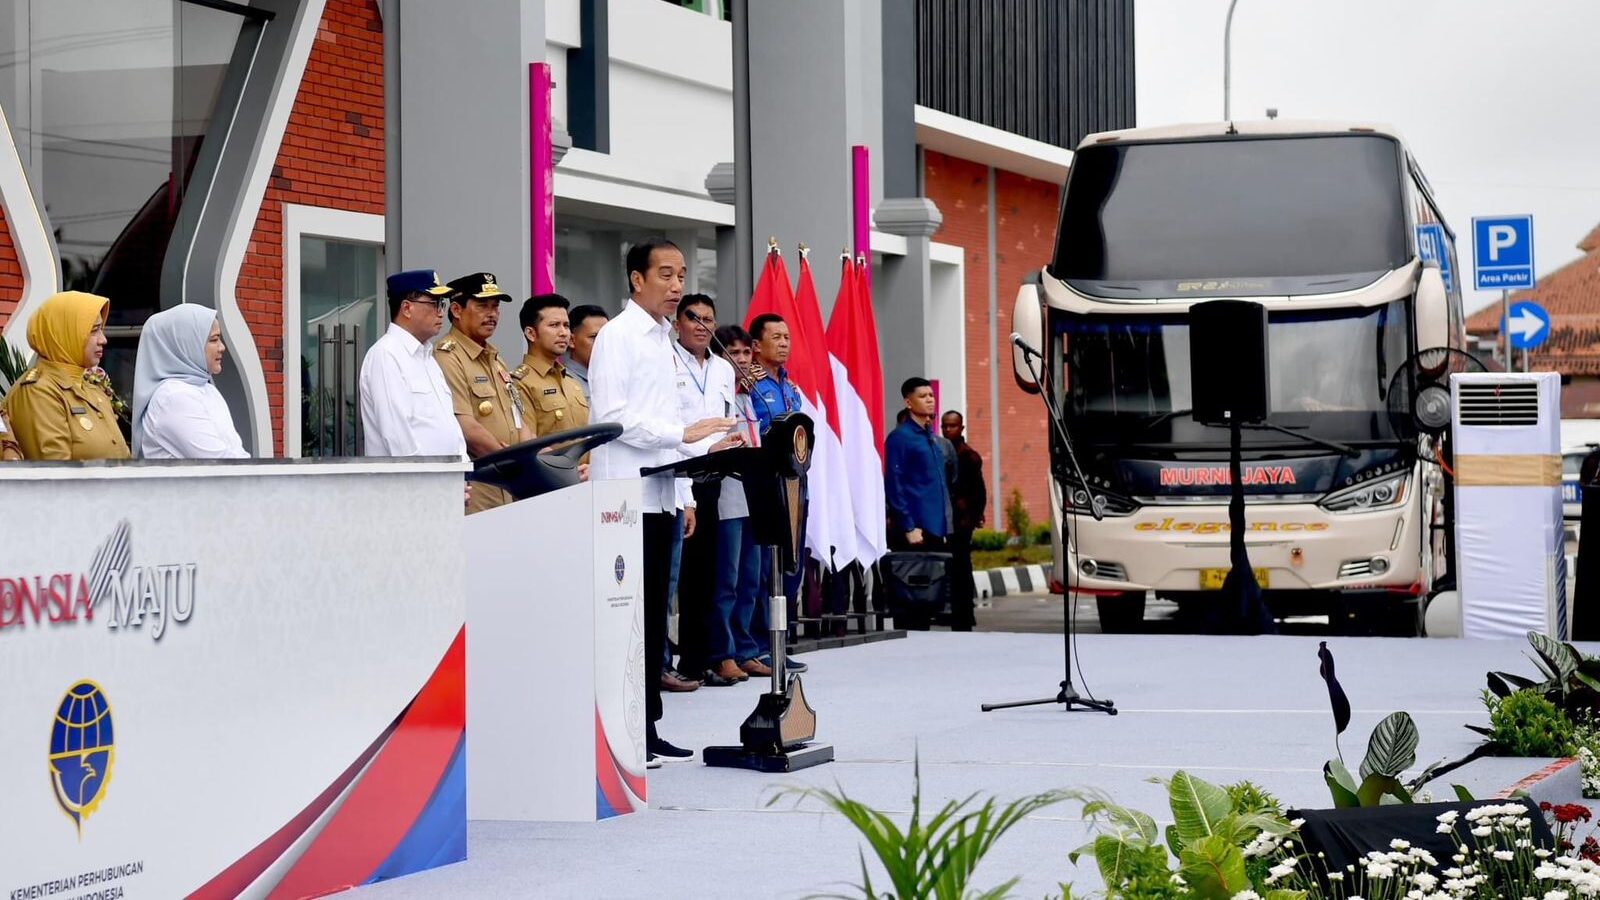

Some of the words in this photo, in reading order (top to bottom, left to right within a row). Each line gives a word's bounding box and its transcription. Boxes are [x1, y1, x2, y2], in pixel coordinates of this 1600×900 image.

[1488, 225, 1517, 261] P
[1480, 274, 1501, 284] Area
[1502, 272, 1529, 282] Parkir
[1241, 467, 1296, 484] JAYA
[106, 564, 196, 640] MAJU
[10, 876, 76, 900] KEMENTERIAN
[78, 861, 143, 887] PERHUBUNGAN
